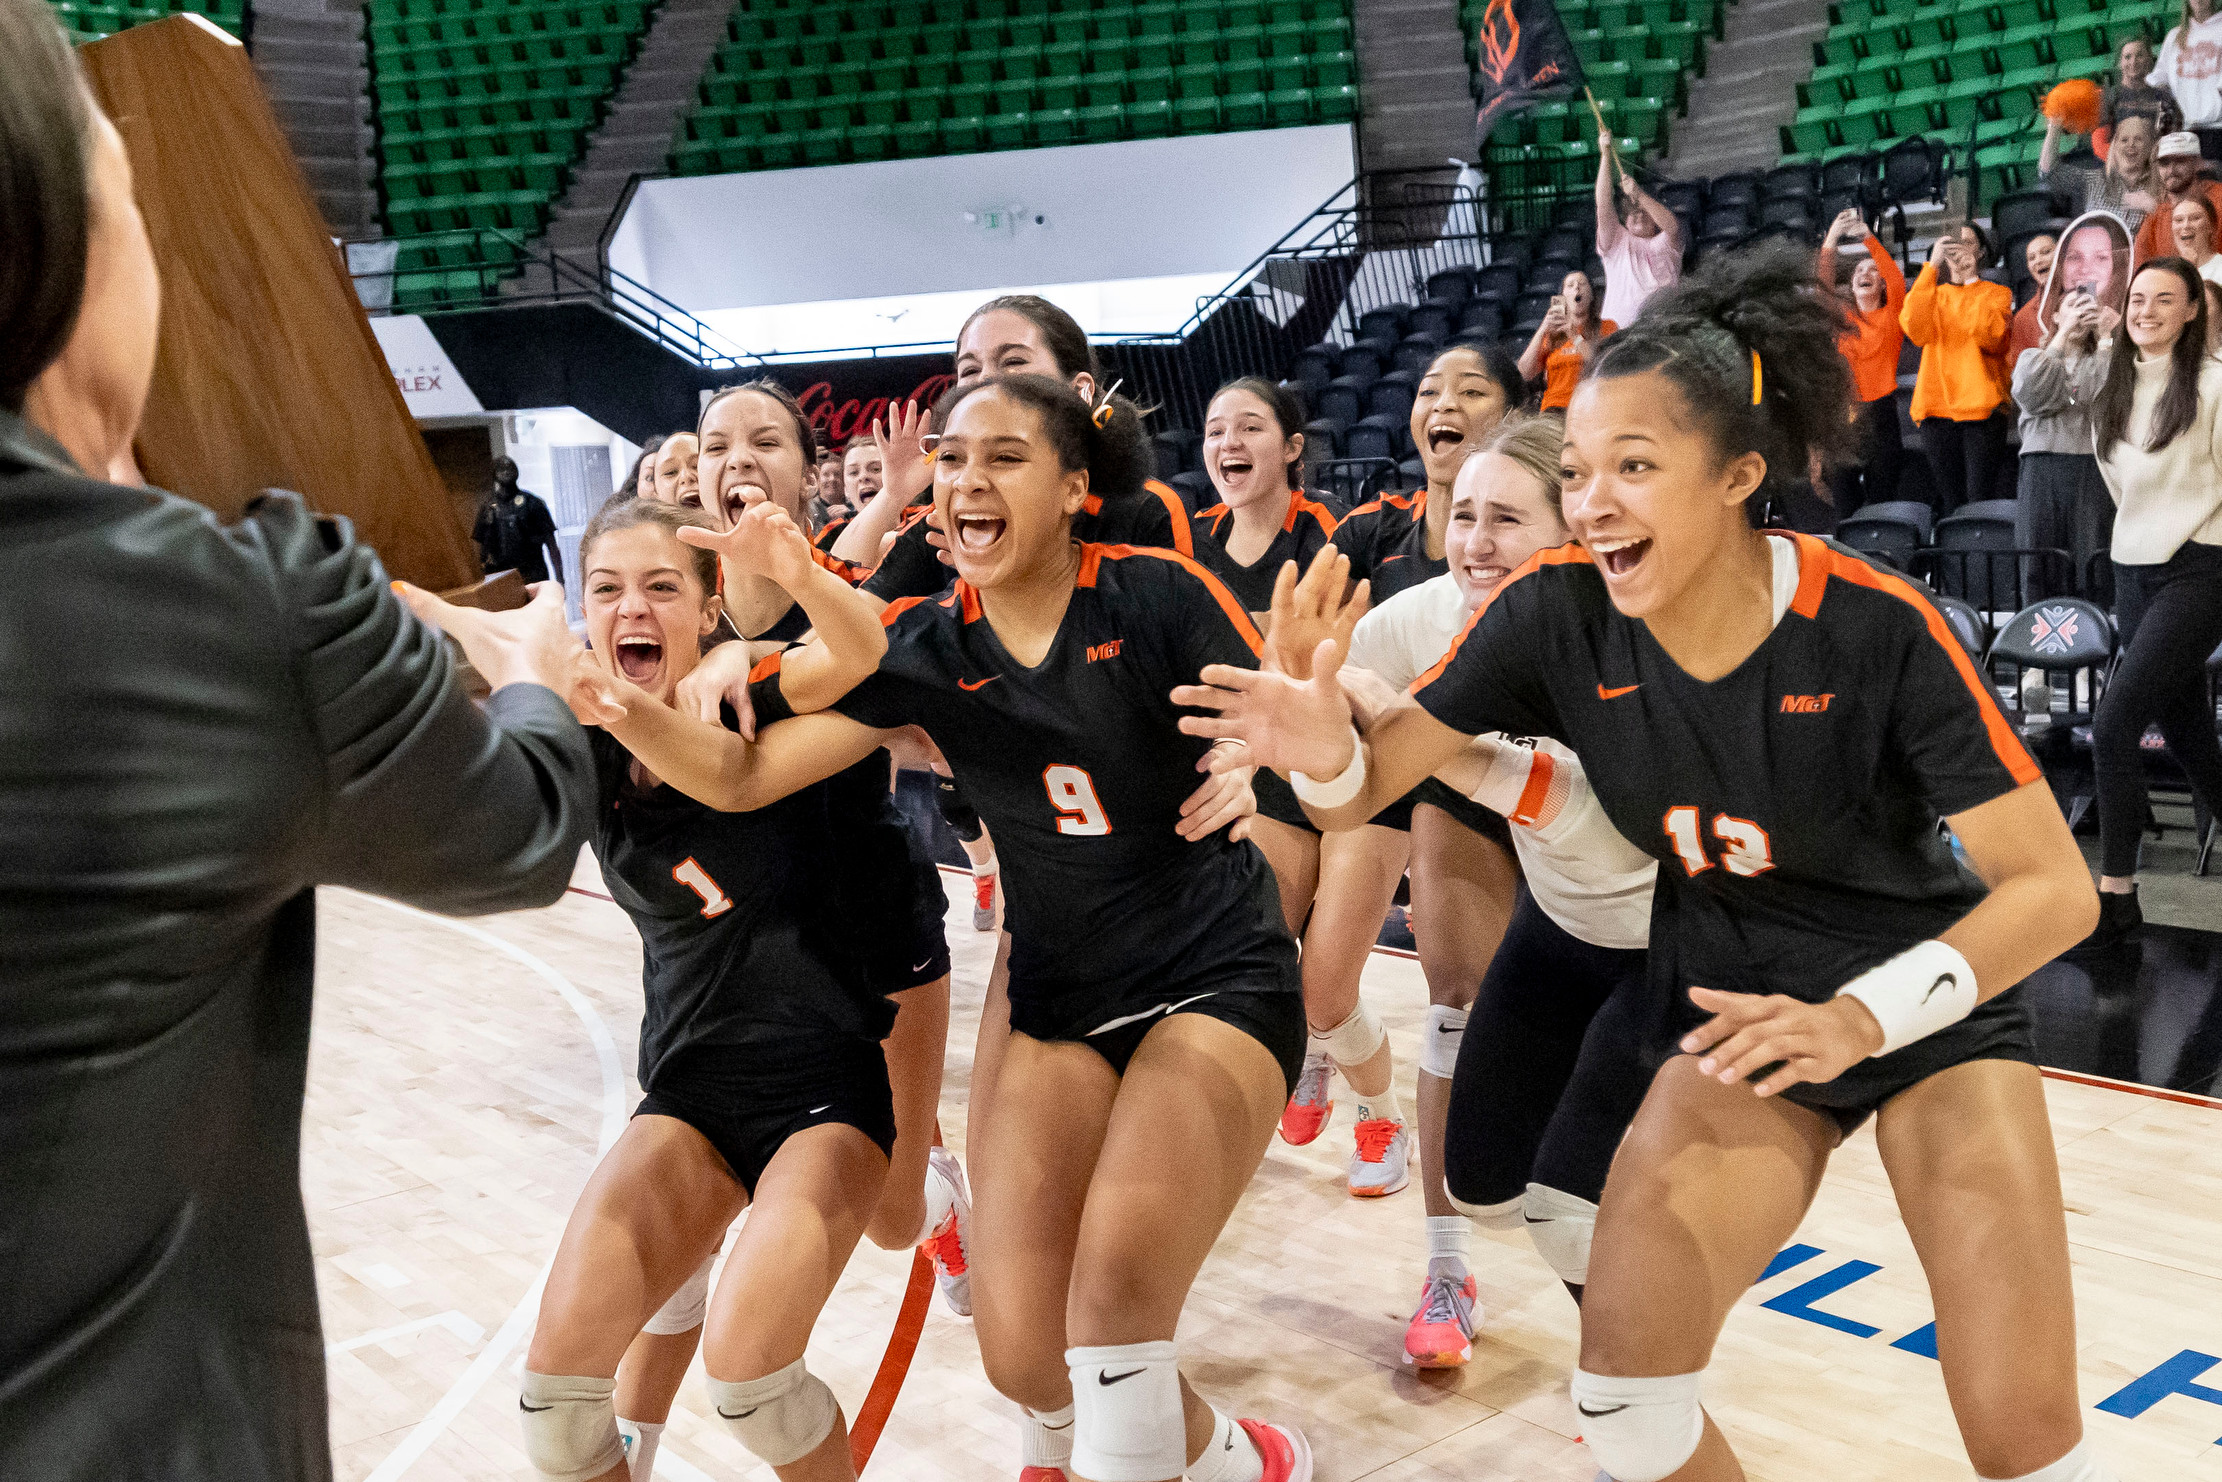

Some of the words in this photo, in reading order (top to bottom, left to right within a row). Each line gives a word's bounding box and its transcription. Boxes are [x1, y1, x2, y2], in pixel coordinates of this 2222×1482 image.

[1042, 763, 1112, 836] 9
[1663, 805, 1778, 877] 13
[672, 856, 733, 919] 1
